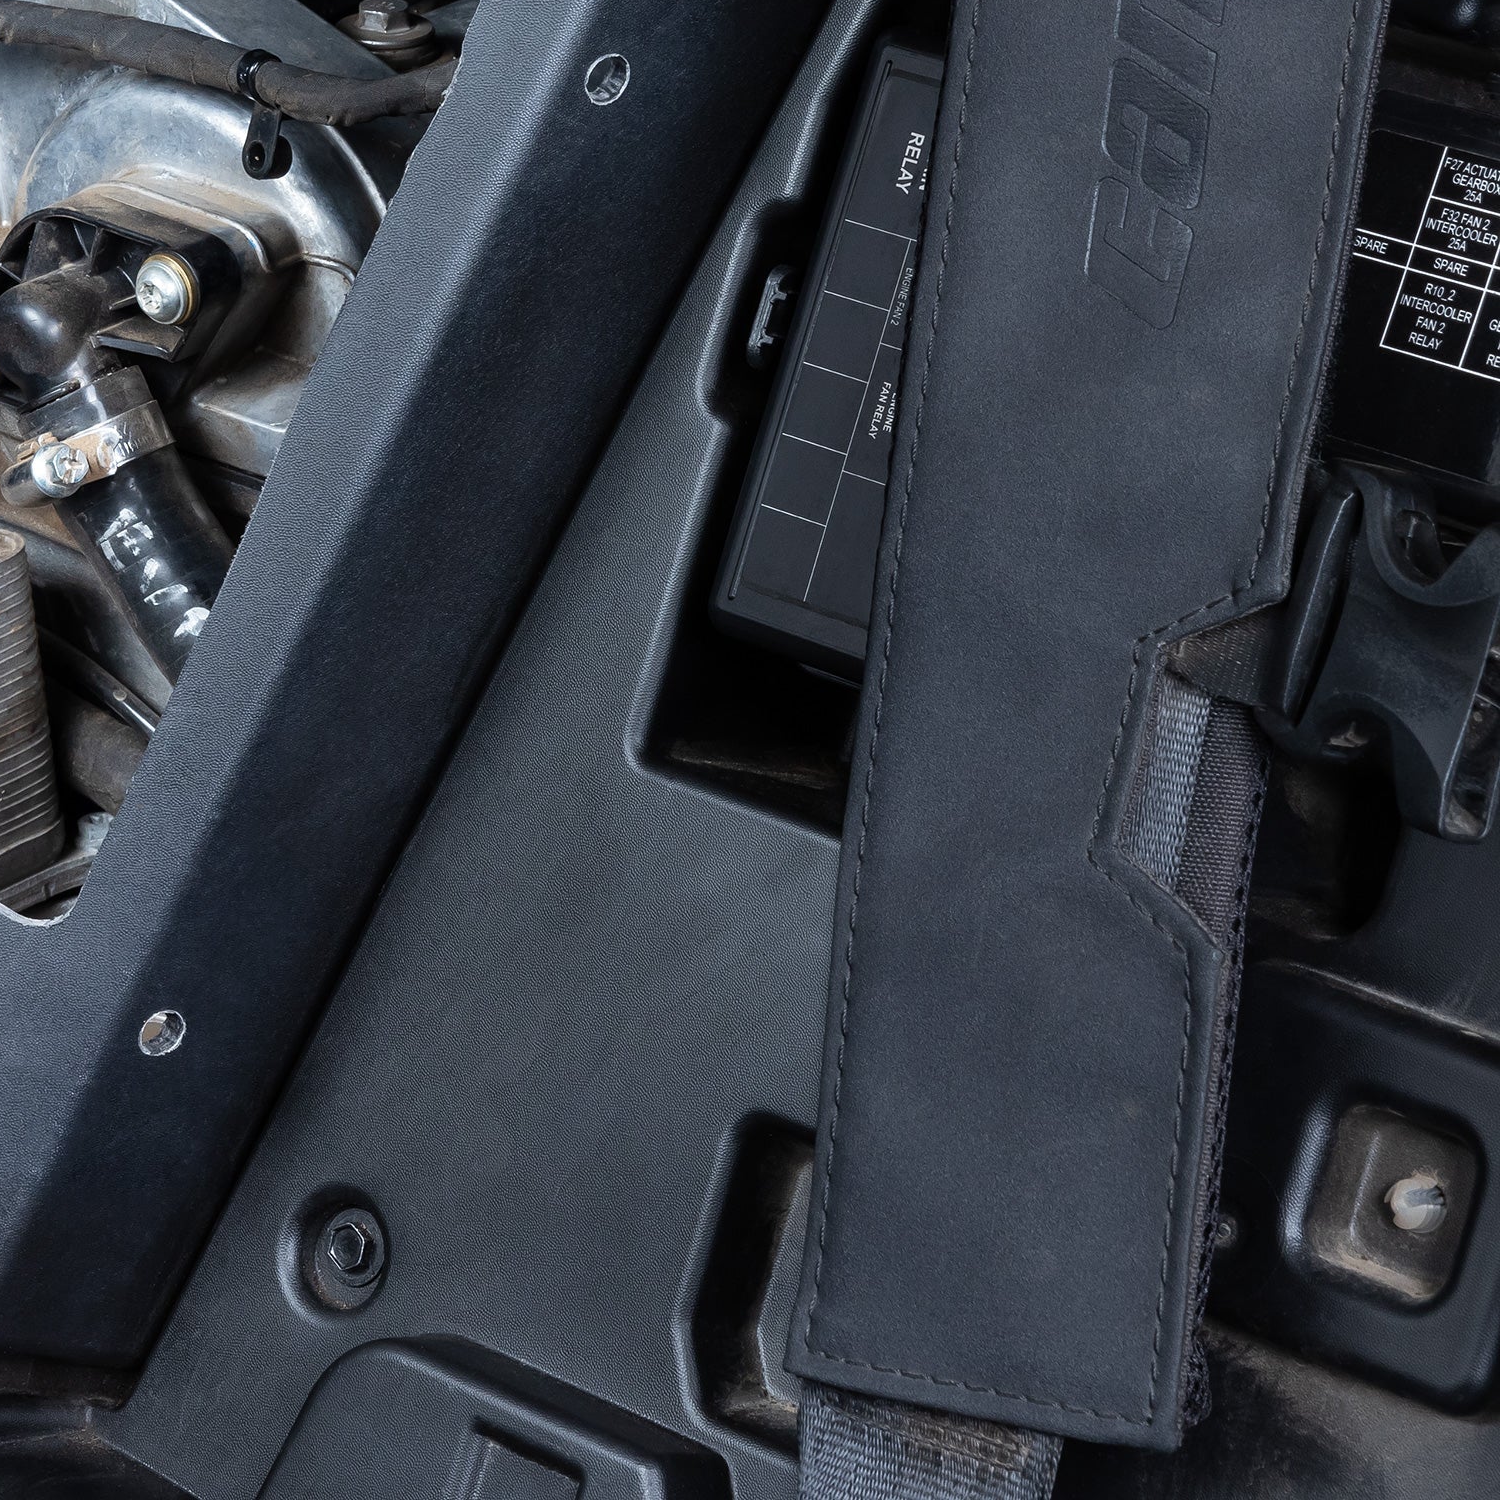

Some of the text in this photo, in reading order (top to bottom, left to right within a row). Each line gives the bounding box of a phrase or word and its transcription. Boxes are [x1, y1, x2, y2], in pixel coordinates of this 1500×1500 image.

[895, 131, 925, 195] RELAY
[1444, 157, 1464, 171] F27
[1463, 189, 1482, 204] 25A
[1441, 208, 1491, 231] F32 FAN 2
[1425, 217, 1498, 246] INTERCOOLER
[1353, 235, 1388, 254] SPARE
[1447, 237, 1466, 252] 25A
[1433, 257, 1469, 277] SPARE
[898, 267, 913, 300] ENGINE
[1423, 282, 1456, 301] R10_2
[893, 301, 905, 320] FAN
[1399, 293, 1473, 324] INTERCOOLER
[1415, 316, 1446, 334] FAN 2
[1408, 331, 1443, 350] RELAY
[868, 381, 891, 440] FAN RELAY
